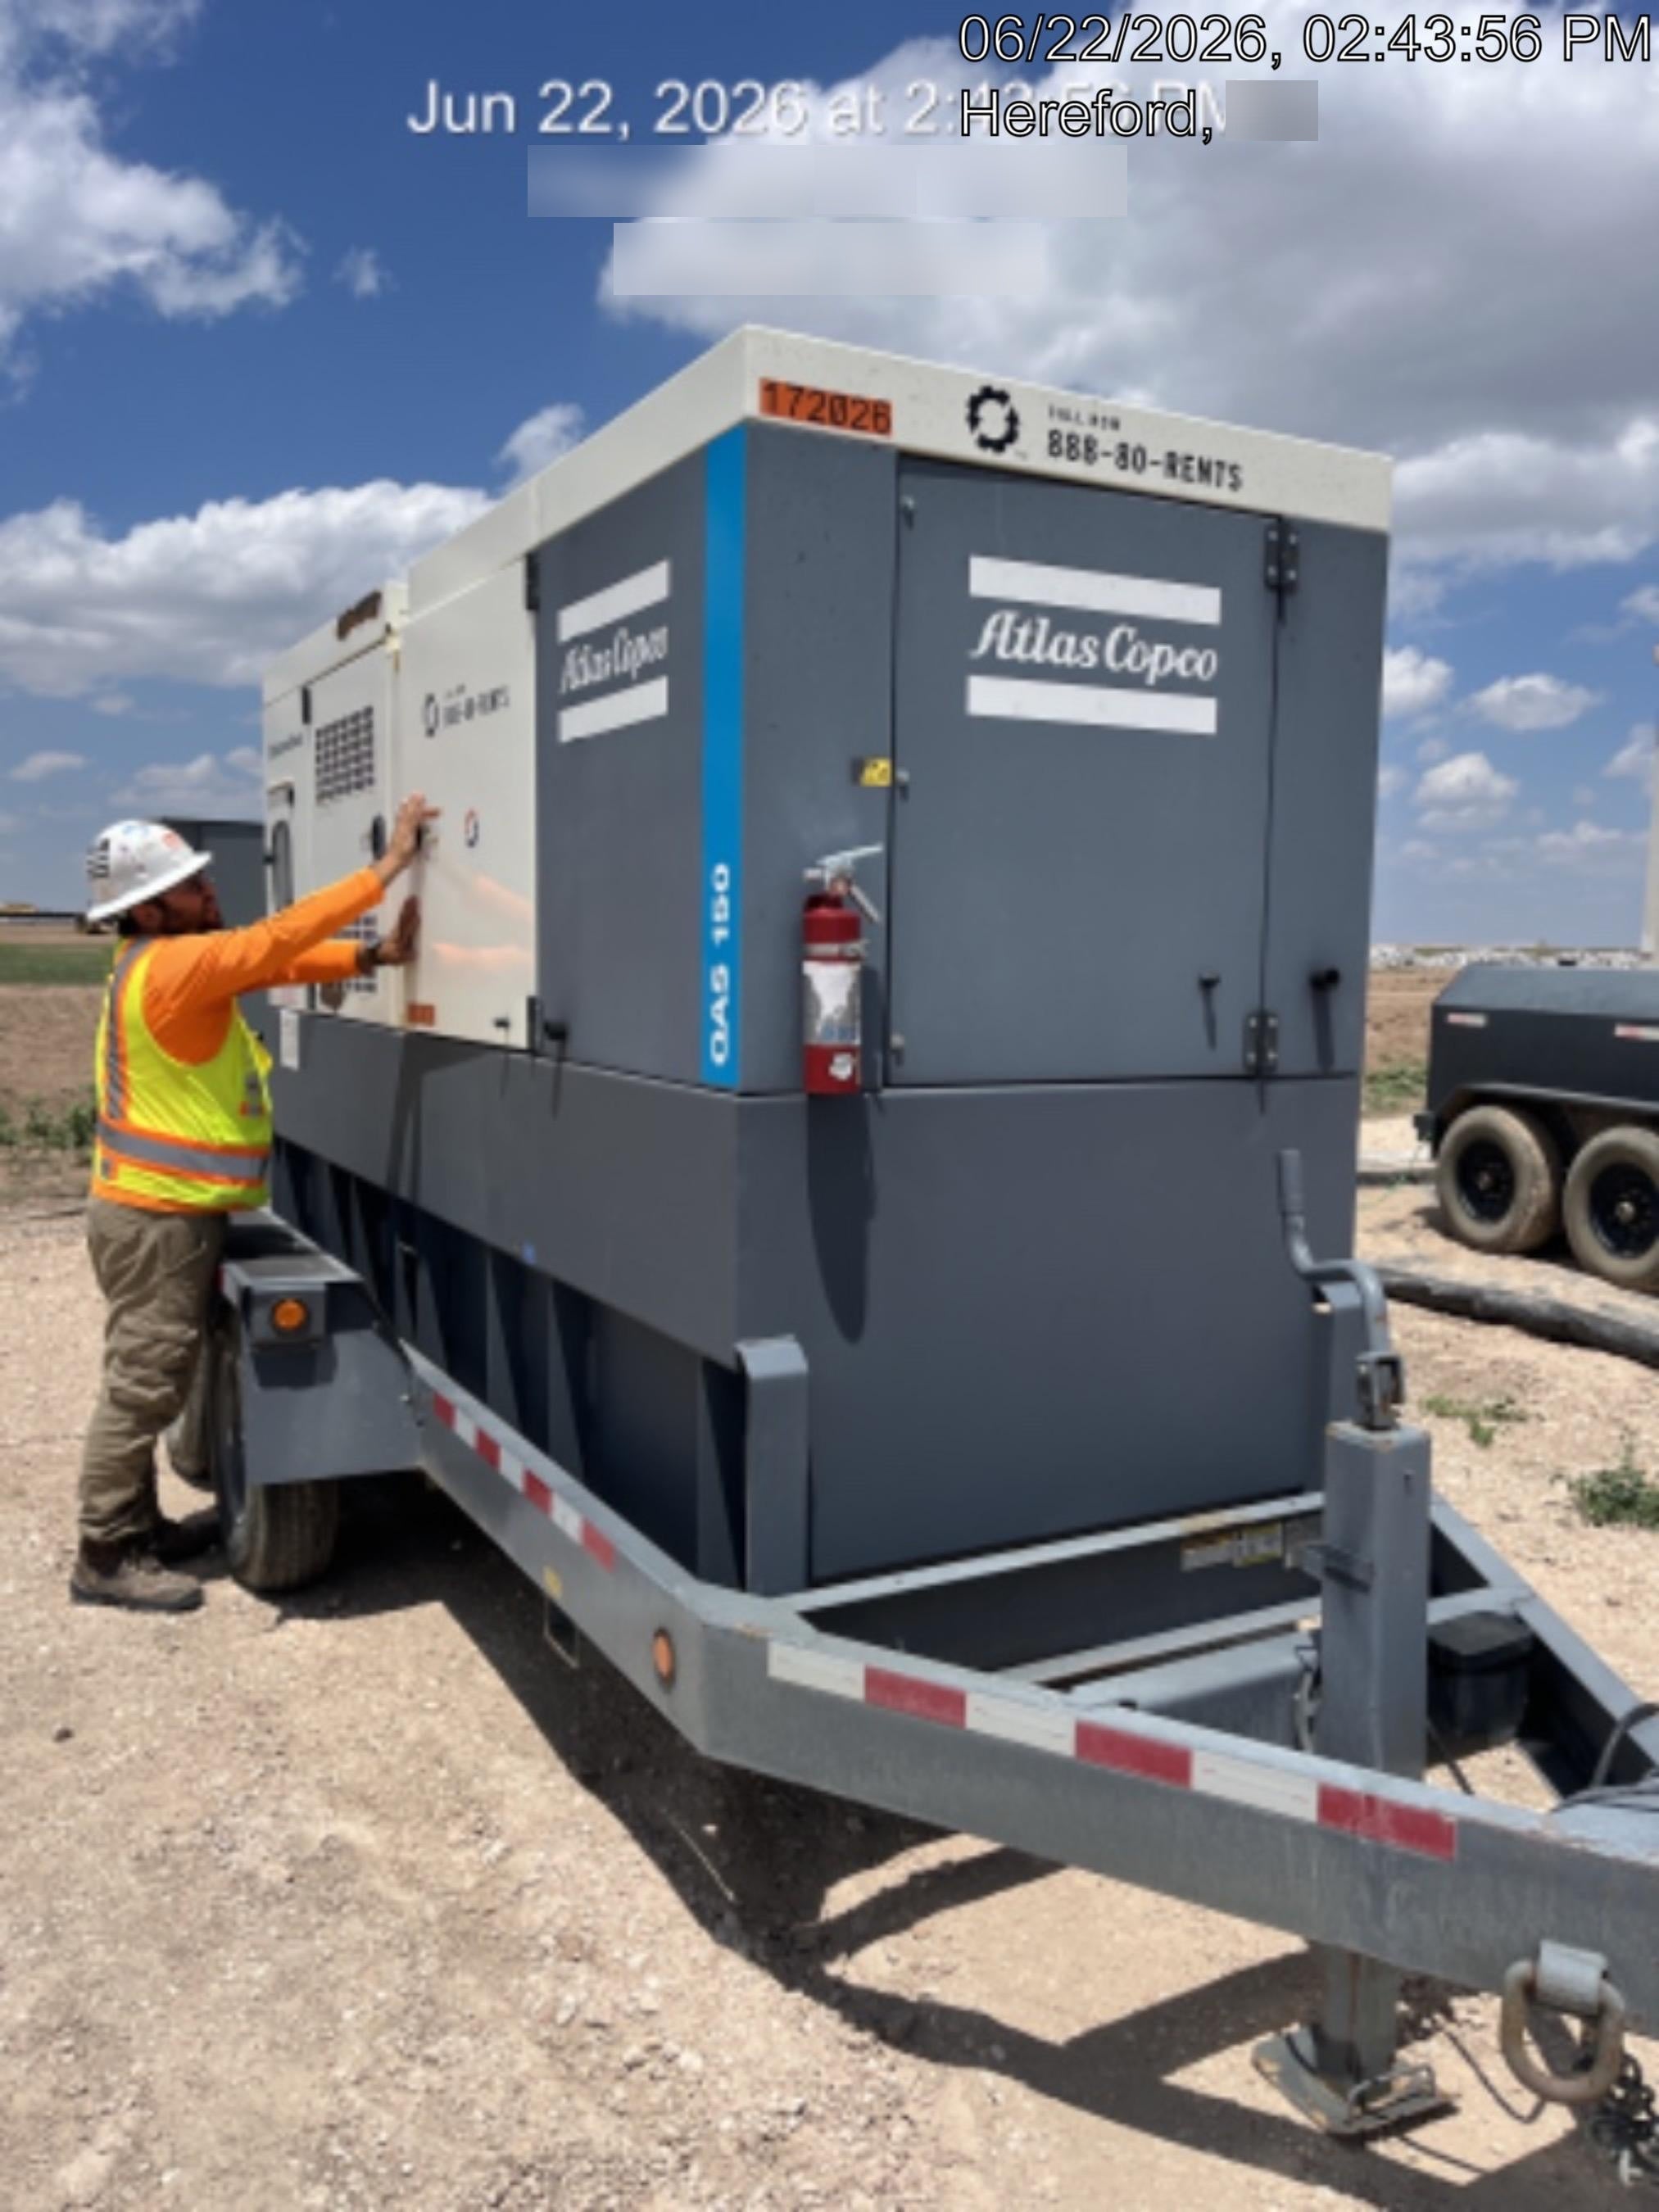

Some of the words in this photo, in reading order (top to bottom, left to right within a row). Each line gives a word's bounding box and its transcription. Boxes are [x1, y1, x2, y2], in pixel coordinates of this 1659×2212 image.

[763, 381, 892, 434] 172026
[1047, 428, 1242, 492] 888-80-RENTS
[970, 610, 1100, 669] Atlas
[1104, 624, 1218, 686] Copco
